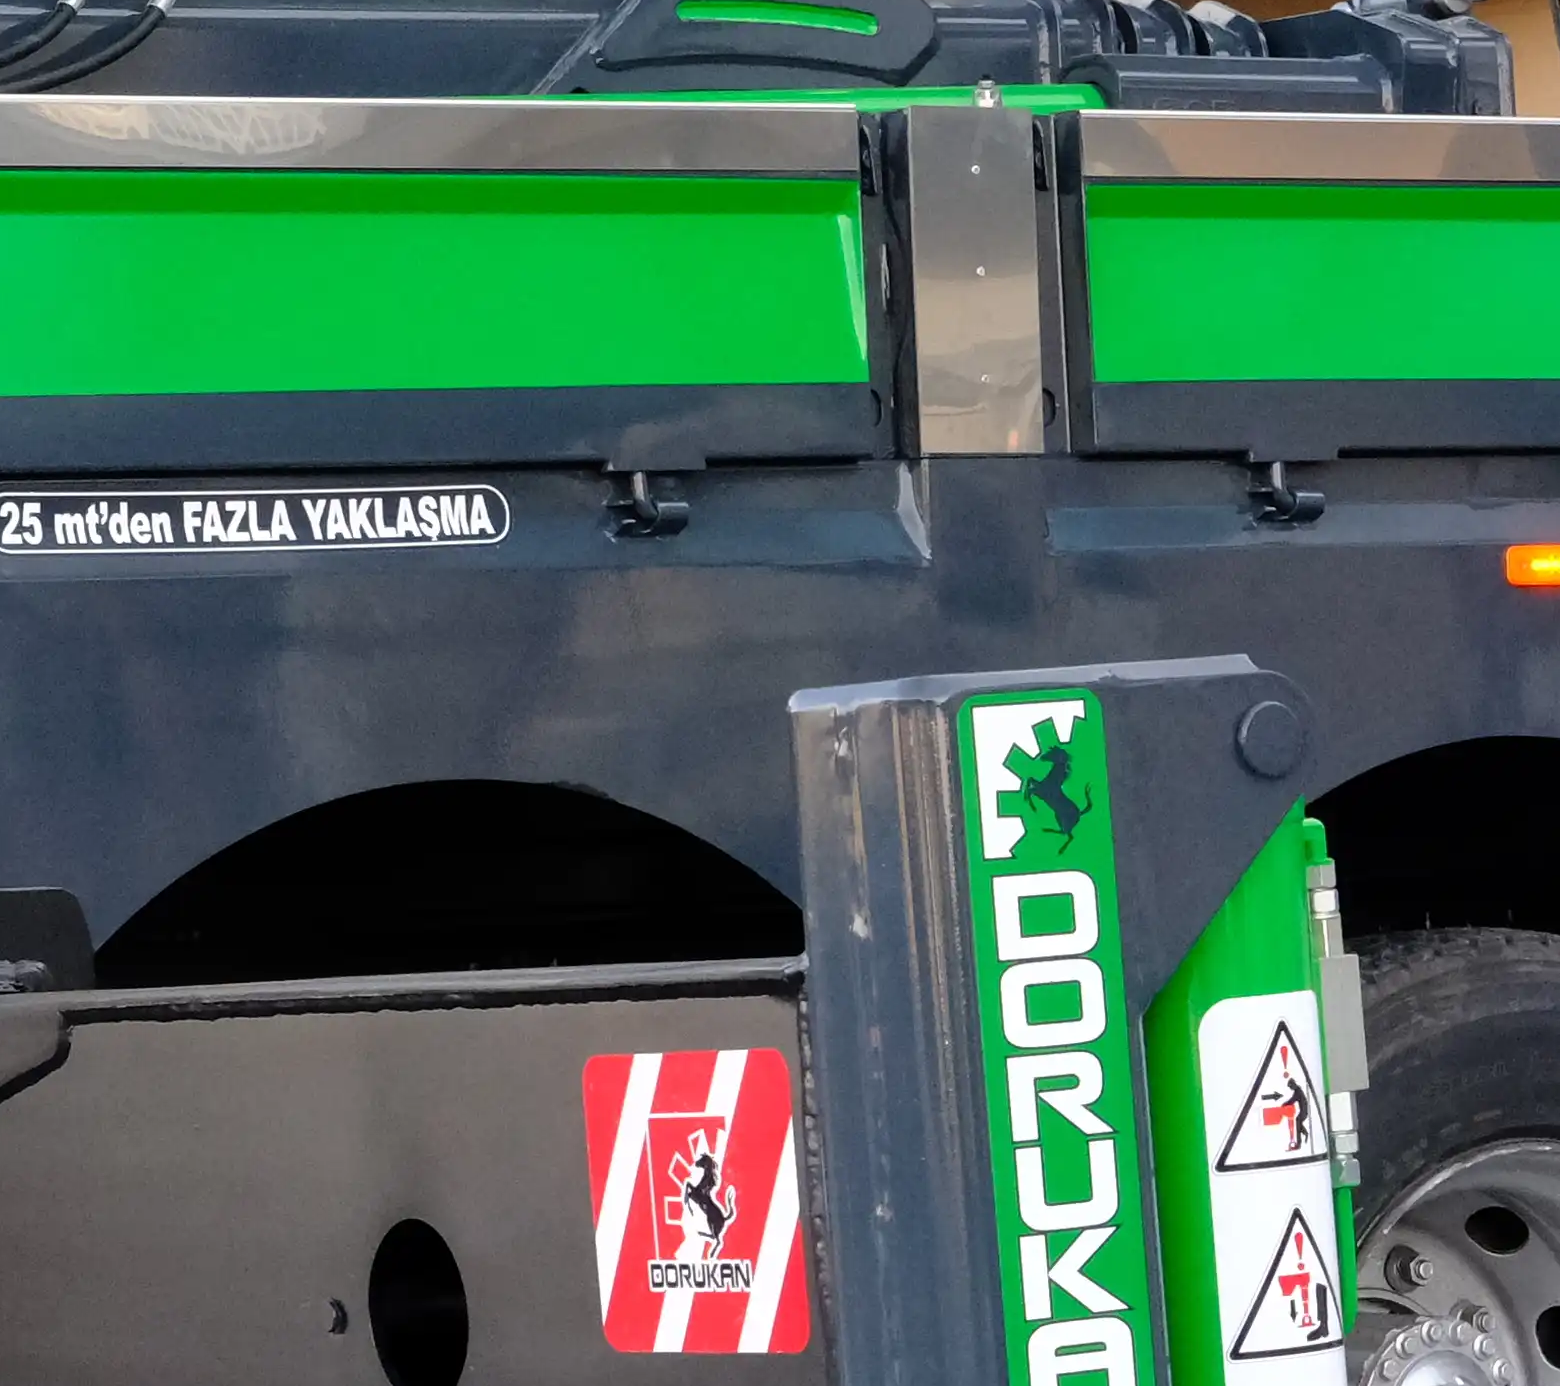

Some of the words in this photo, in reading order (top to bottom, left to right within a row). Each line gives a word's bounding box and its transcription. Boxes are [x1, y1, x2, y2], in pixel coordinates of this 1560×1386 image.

[0, 502, 42, 546] 25
[183, 500, 296, 544] FAZLA
[301, 494, 496, 542] YAKLAŞMA
[650, 1263, 751, 1288] DORUKAN
